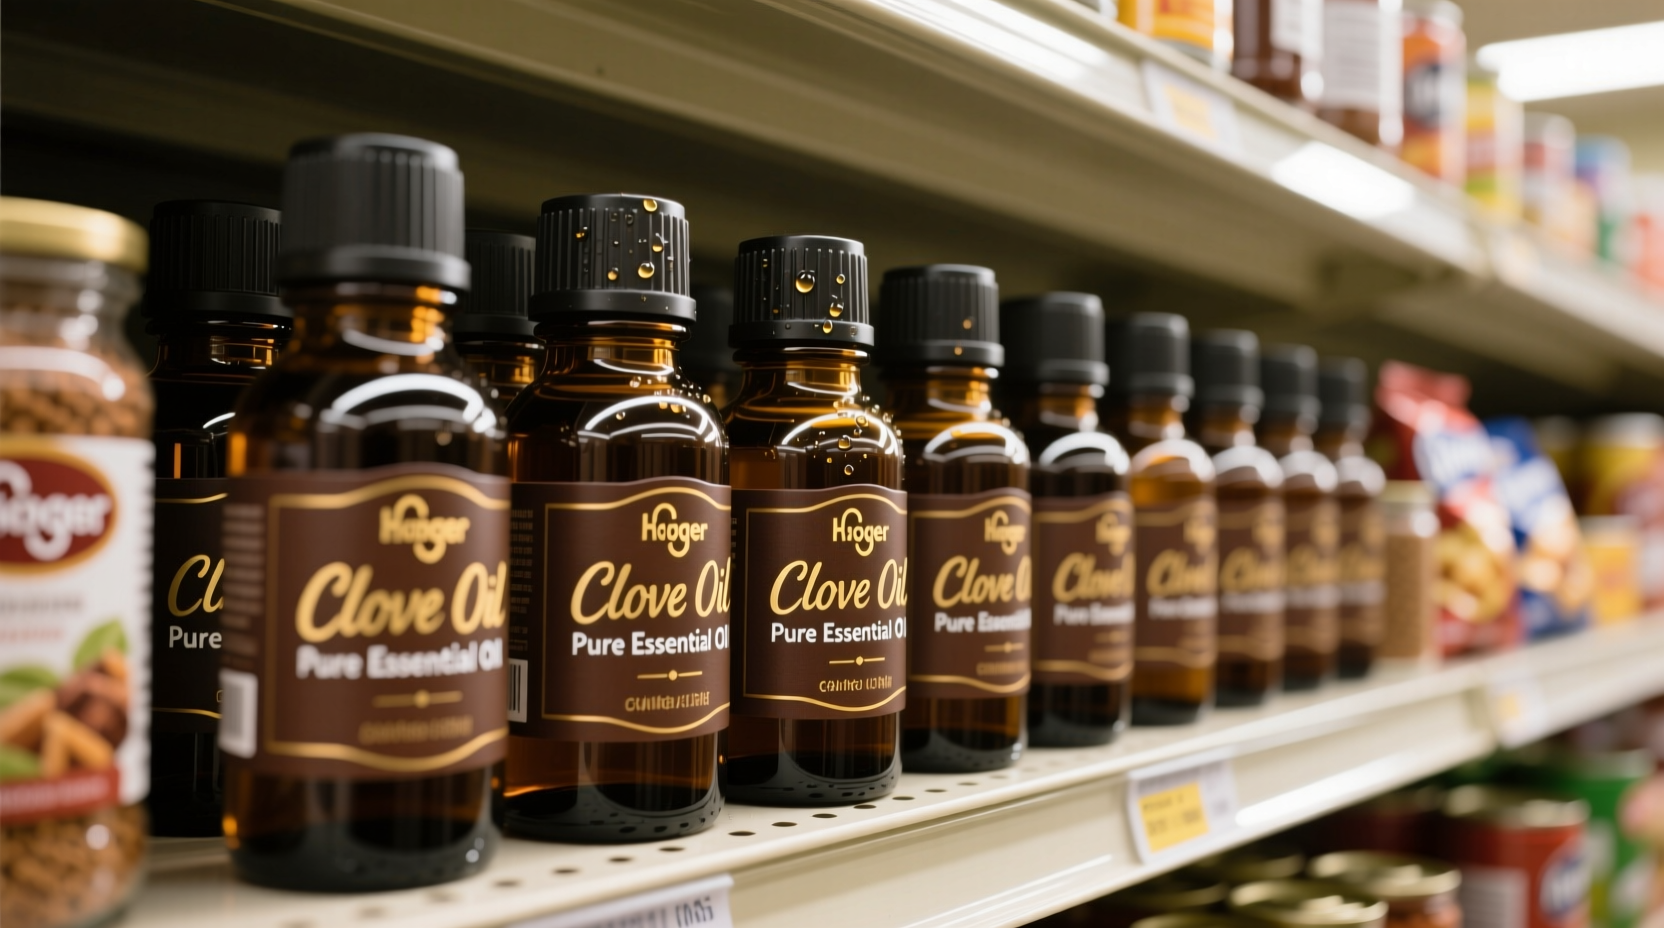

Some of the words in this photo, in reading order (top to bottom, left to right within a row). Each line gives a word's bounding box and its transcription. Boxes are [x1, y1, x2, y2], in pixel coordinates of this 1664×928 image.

[294, 560, 446, 643] Clove
[450, 561, 507, 636] Oil
[570, 561, 687, 626] Clove
[694, 558, 730, 618] Oil
[770, 560, 871, 616] Clove
[876, 557, 907, 611] Oil
[932, 555, 1013, 609] Clove
[169, 625, 222, 649] Pure
[571, 631, 625, 657] Pure
[631, 627, 712, 657] Essential
[771, 622, 818, 644] Pure
[823, 619, 893, 644] Essential
[934, 611, 975, 634] Pure
[295, 645, 364, 681] Pure
[366, 640, 477, 680] Essential
